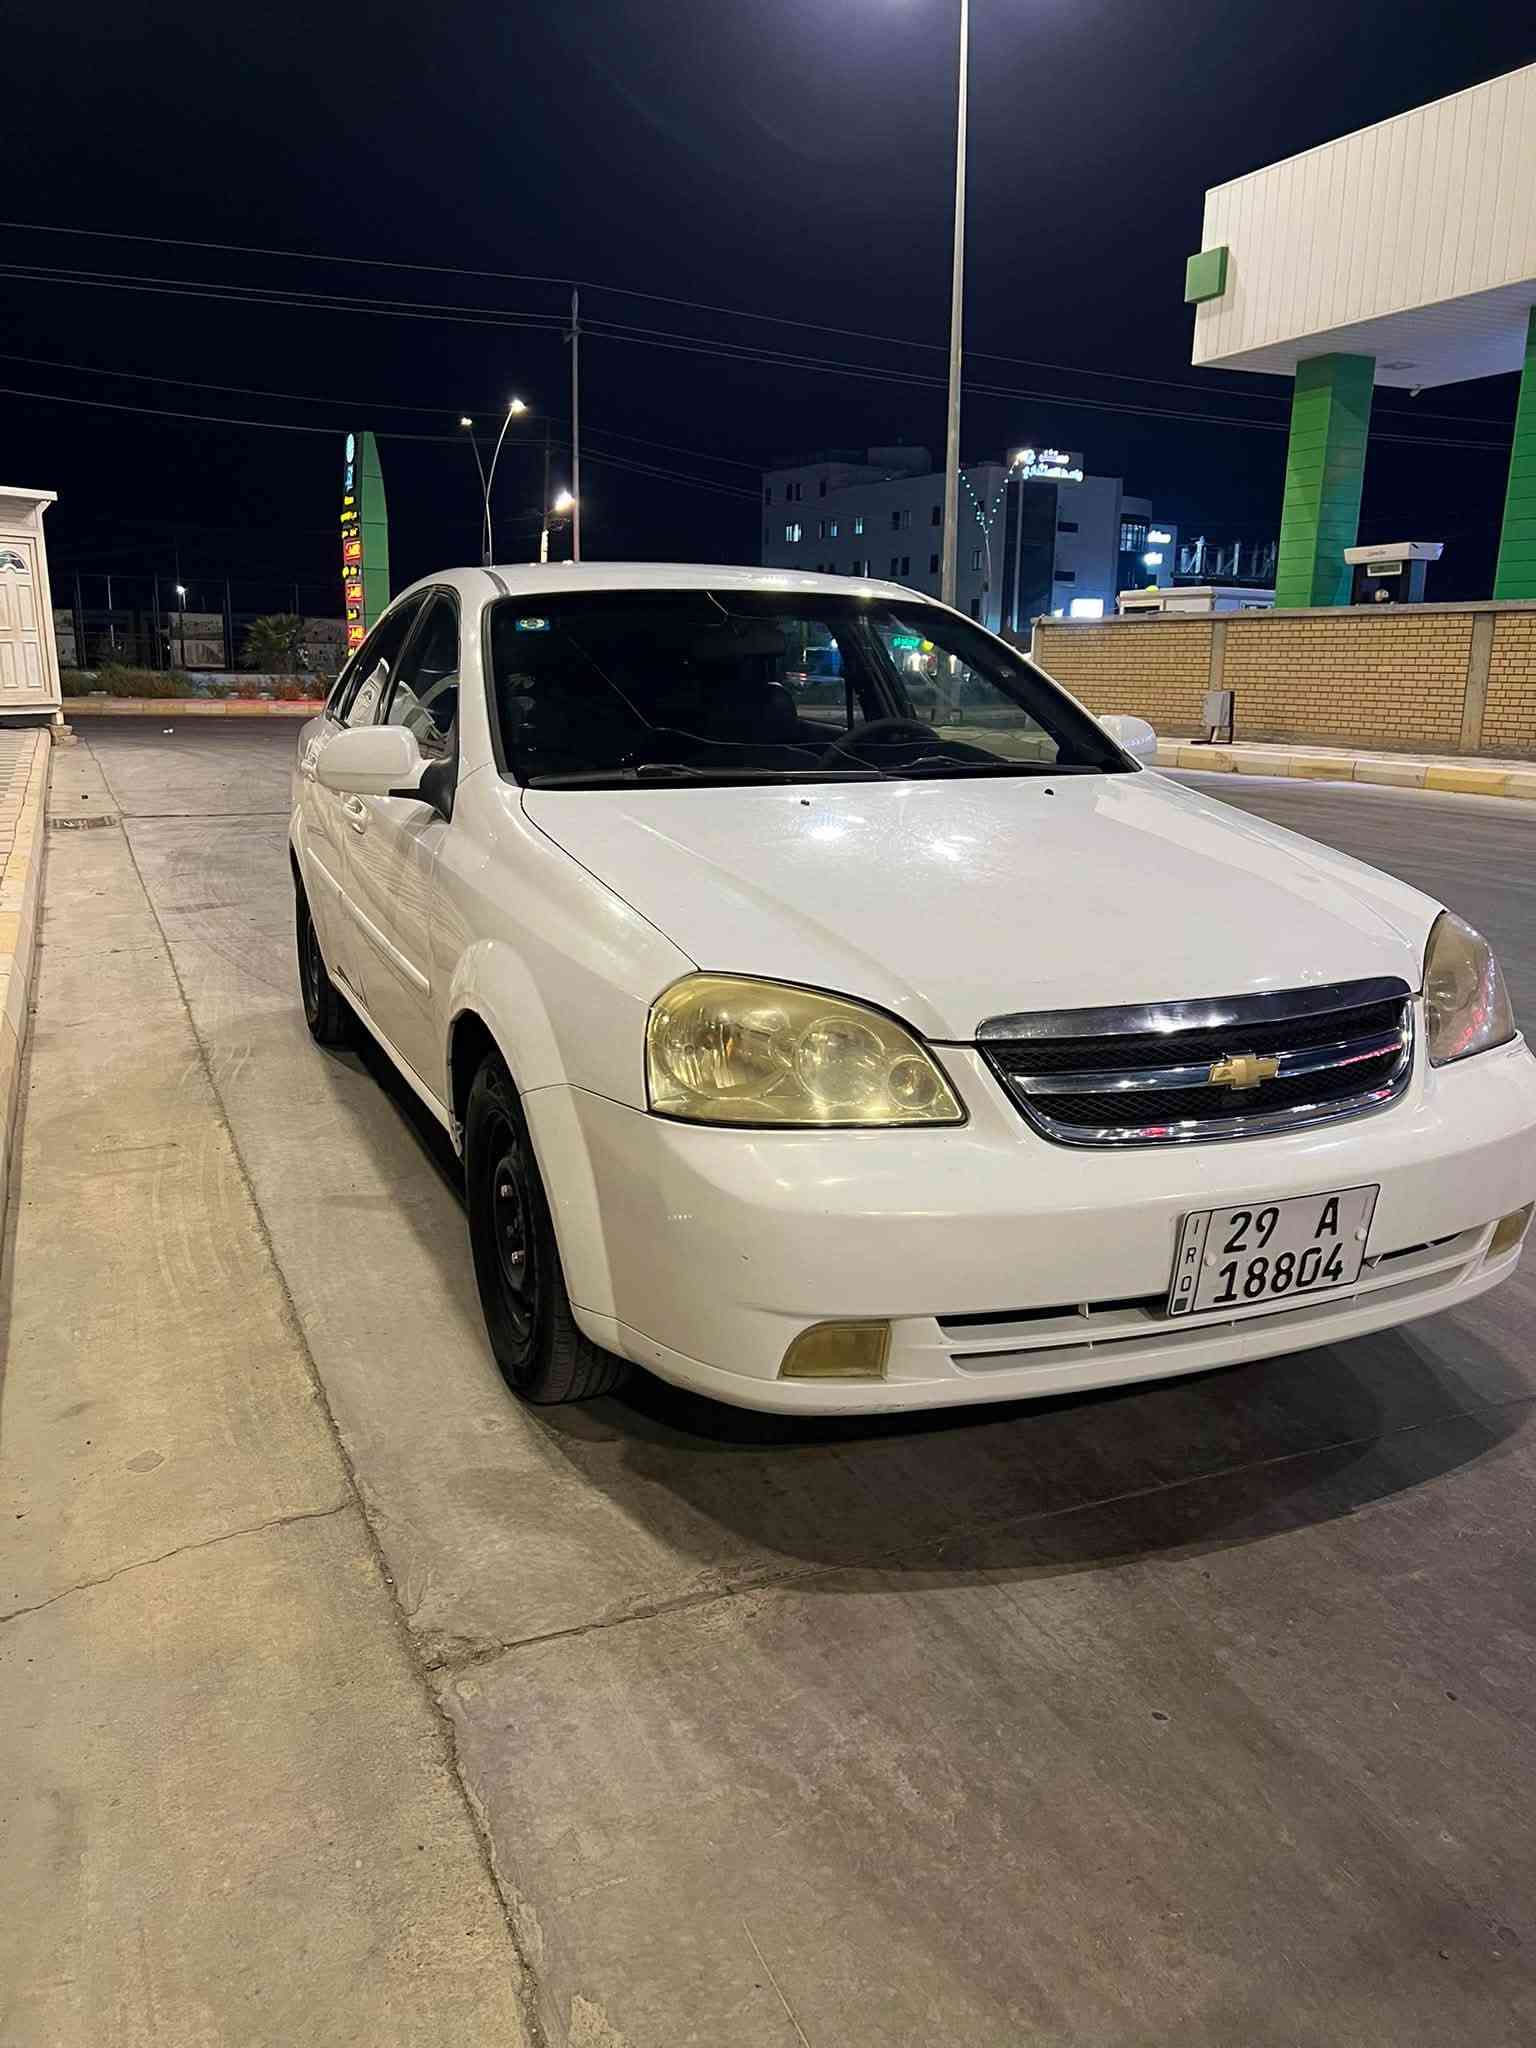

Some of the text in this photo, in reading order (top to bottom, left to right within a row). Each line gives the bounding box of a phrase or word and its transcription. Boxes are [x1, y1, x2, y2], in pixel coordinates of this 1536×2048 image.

[1224, 1197, 1340, 1253] 29 A
[1213, 1242, 1343, 1303] 18804
